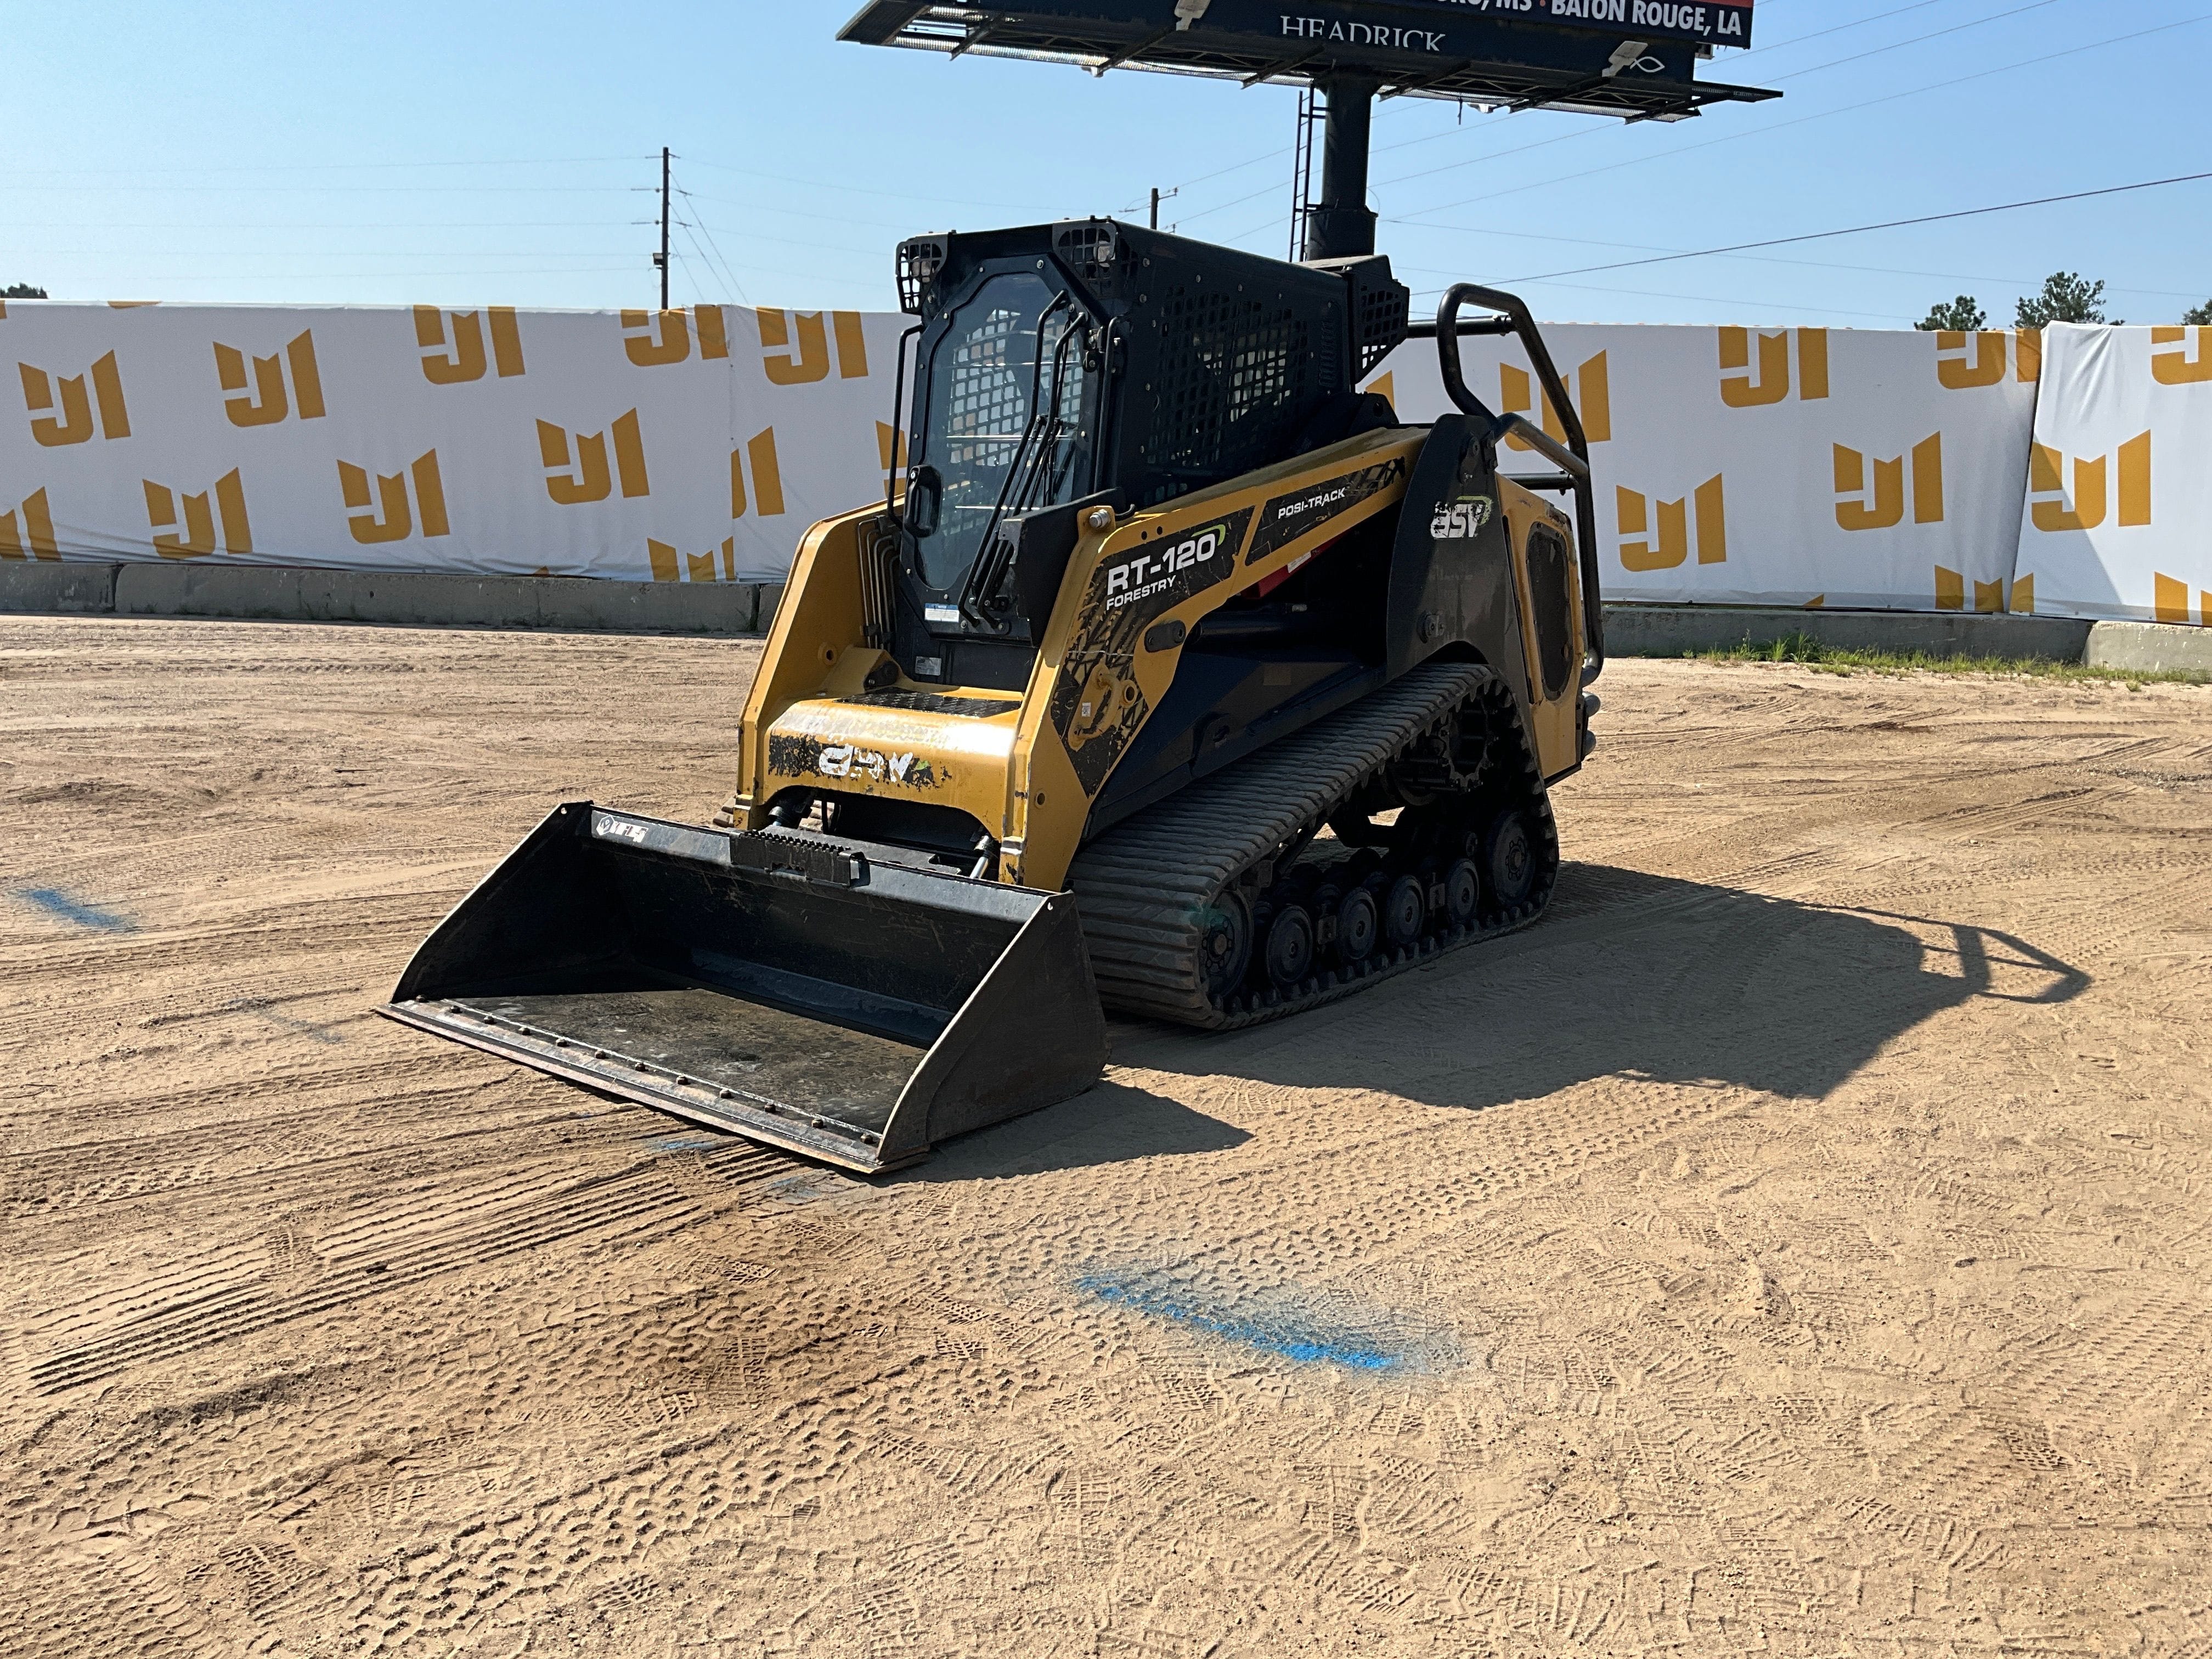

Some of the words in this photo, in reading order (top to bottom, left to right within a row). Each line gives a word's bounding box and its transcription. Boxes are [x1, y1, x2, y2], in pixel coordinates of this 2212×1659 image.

[1280, 15, 1446, 52] HEADRICK
[1551, 0, 1625, 22] BATON
[1632, 2, 1711, 36] ROUGE,
[1717, 10, 1741, 36] LA
[1278, 487, 1346, 520] POSI-TRACK
[1107, 533, 1216, 596] RT-120
[1106, 575, 1176, 611] FORESTRY
